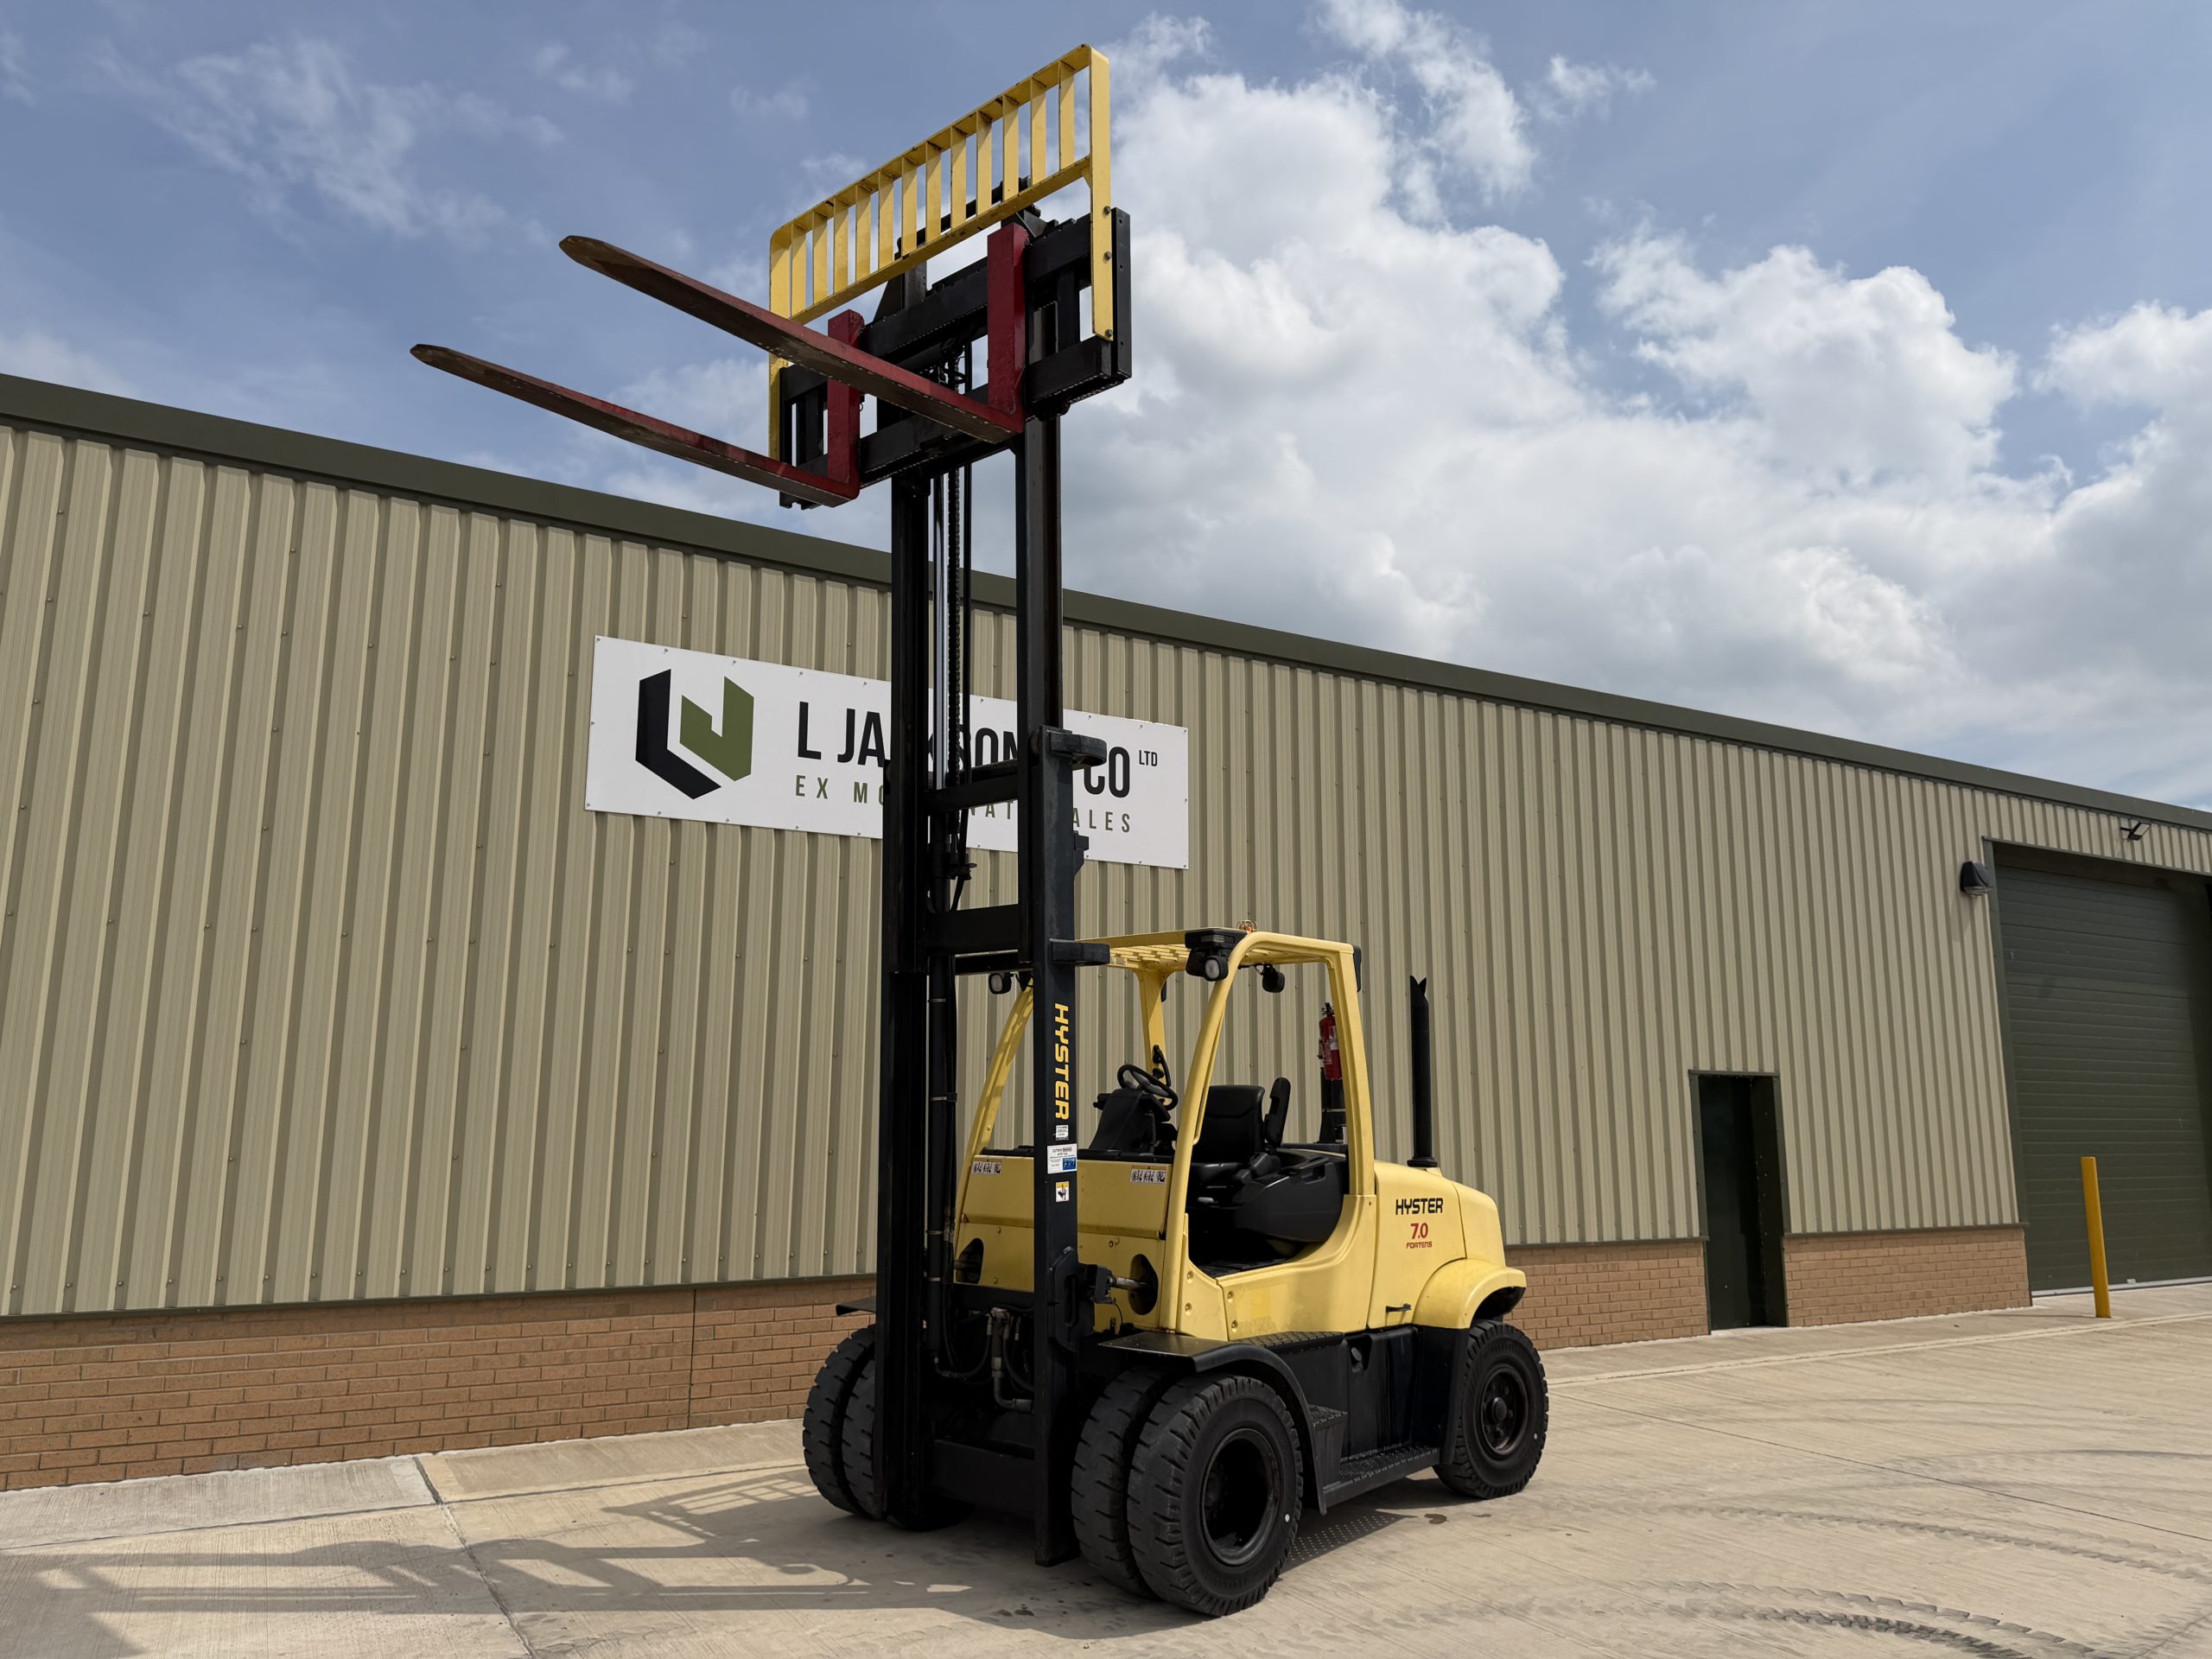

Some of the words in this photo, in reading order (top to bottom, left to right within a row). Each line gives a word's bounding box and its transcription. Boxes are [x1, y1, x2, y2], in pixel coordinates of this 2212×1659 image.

[798, 701, 822, 760] L
[837, 708, 1019, 767] JAON
[1139, 749, 1158, 766] LTD
[796, 774, 829, 799] EX
[1073, 807, 1130, 833] ALES
[1054, 1002, 1070, 1121] HYSTER
[1395, 1198, 1444, 1215] HYSTER
[1406, 1241, 1433, 1249] FORTENS
[1410, 1223, 1429, 1239] 7.0
